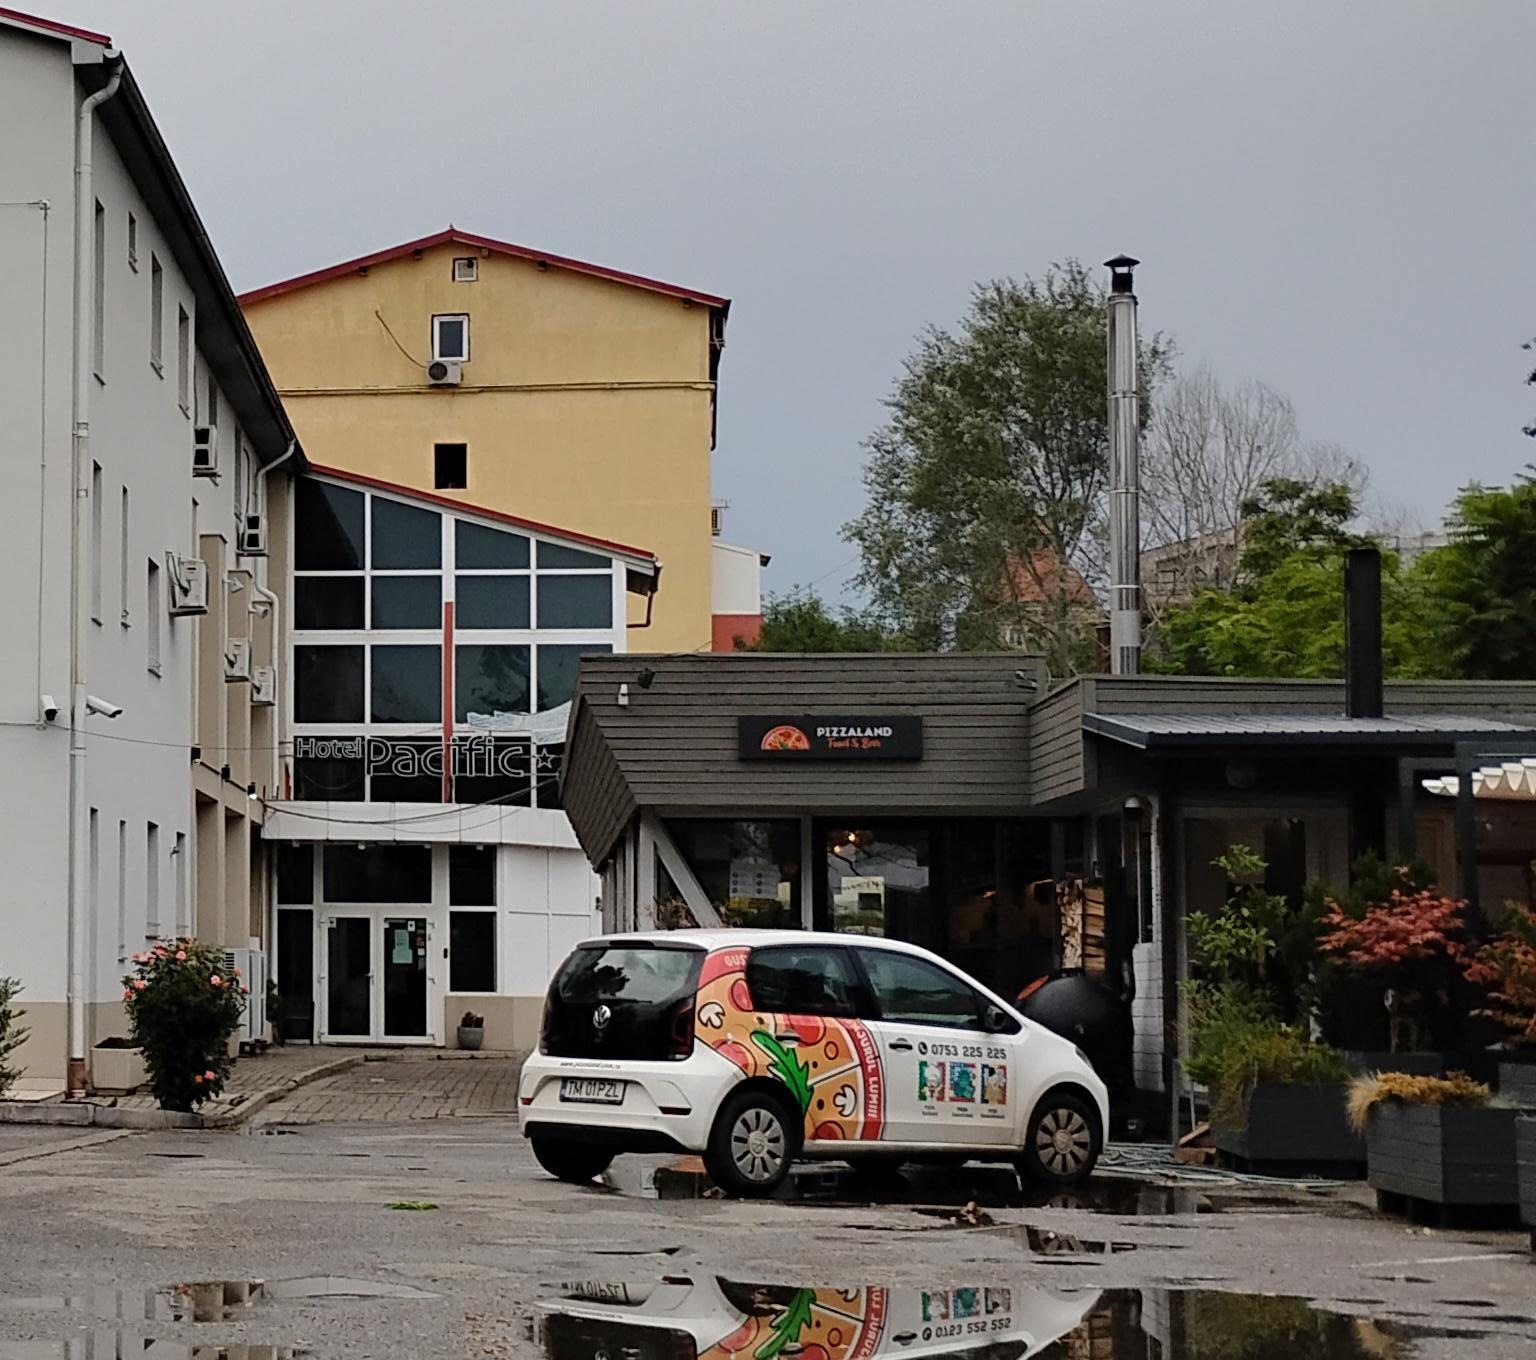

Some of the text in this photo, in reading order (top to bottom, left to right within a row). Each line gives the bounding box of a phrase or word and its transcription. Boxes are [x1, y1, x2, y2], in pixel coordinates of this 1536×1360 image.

[816, 726, 892, 737] PIZZALAND
[296, 735, 524, 777] Hotel Pacific
[931, 1044, 1007, 1059] 0753 225 225
[568, 1081, 584, 1096] TM
